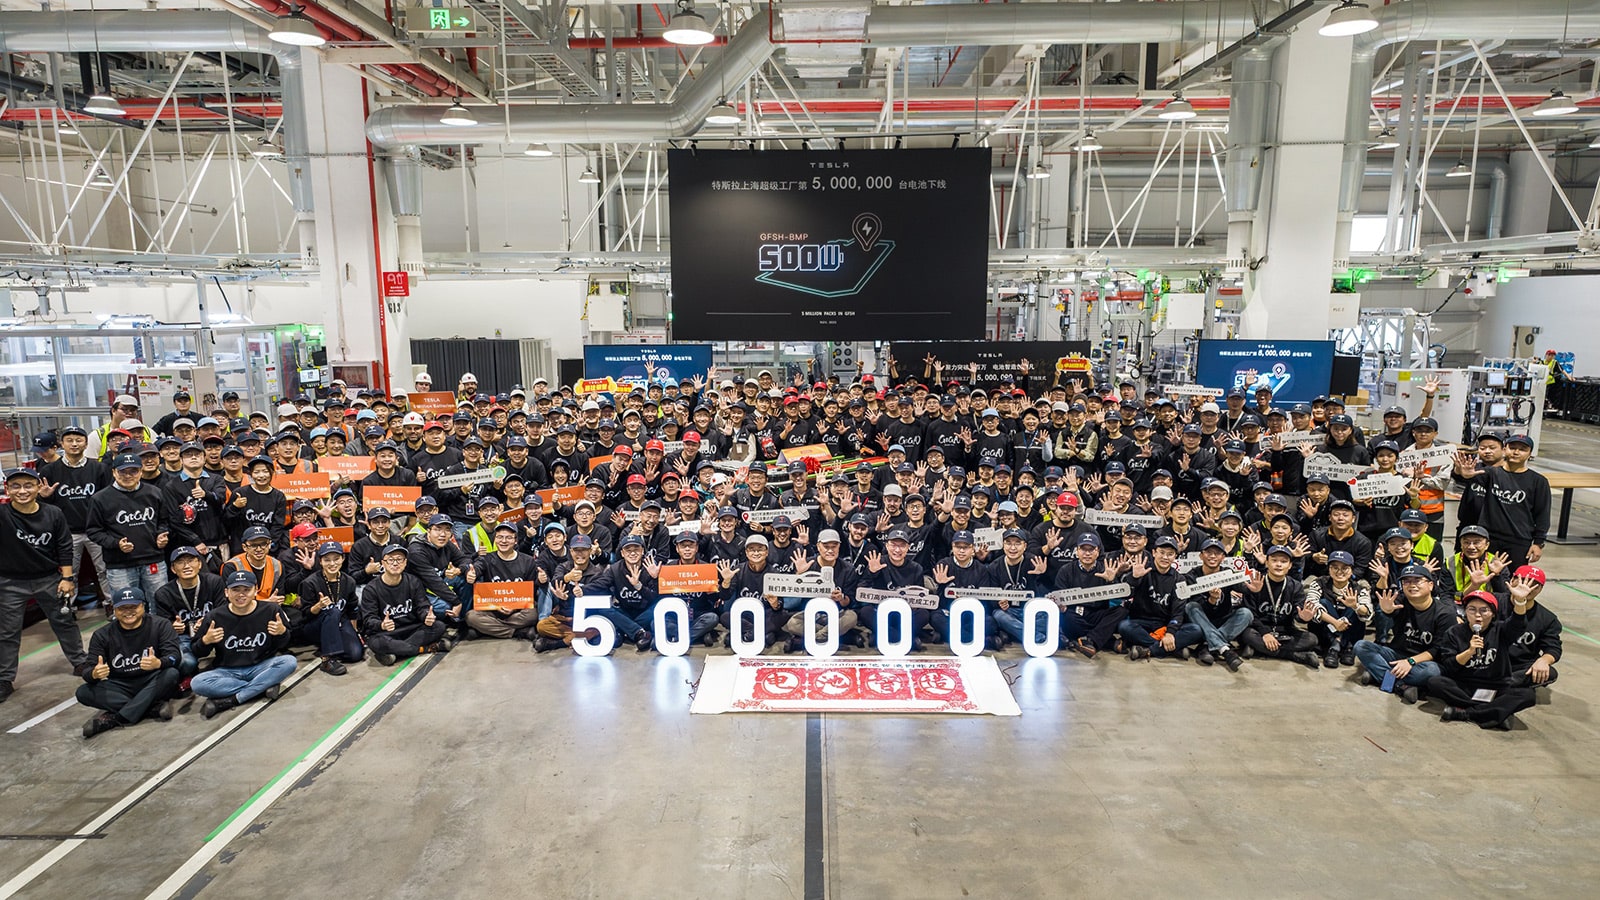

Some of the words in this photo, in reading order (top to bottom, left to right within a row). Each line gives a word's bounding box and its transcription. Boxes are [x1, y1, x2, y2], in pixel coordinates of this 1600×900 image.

[711, 180, 808, 191] 特斯拉上海超级工厂第
[759, 233, 809, 242] GFSH-BMP
[860, 592, 937, 607] 我们高效完成工作
